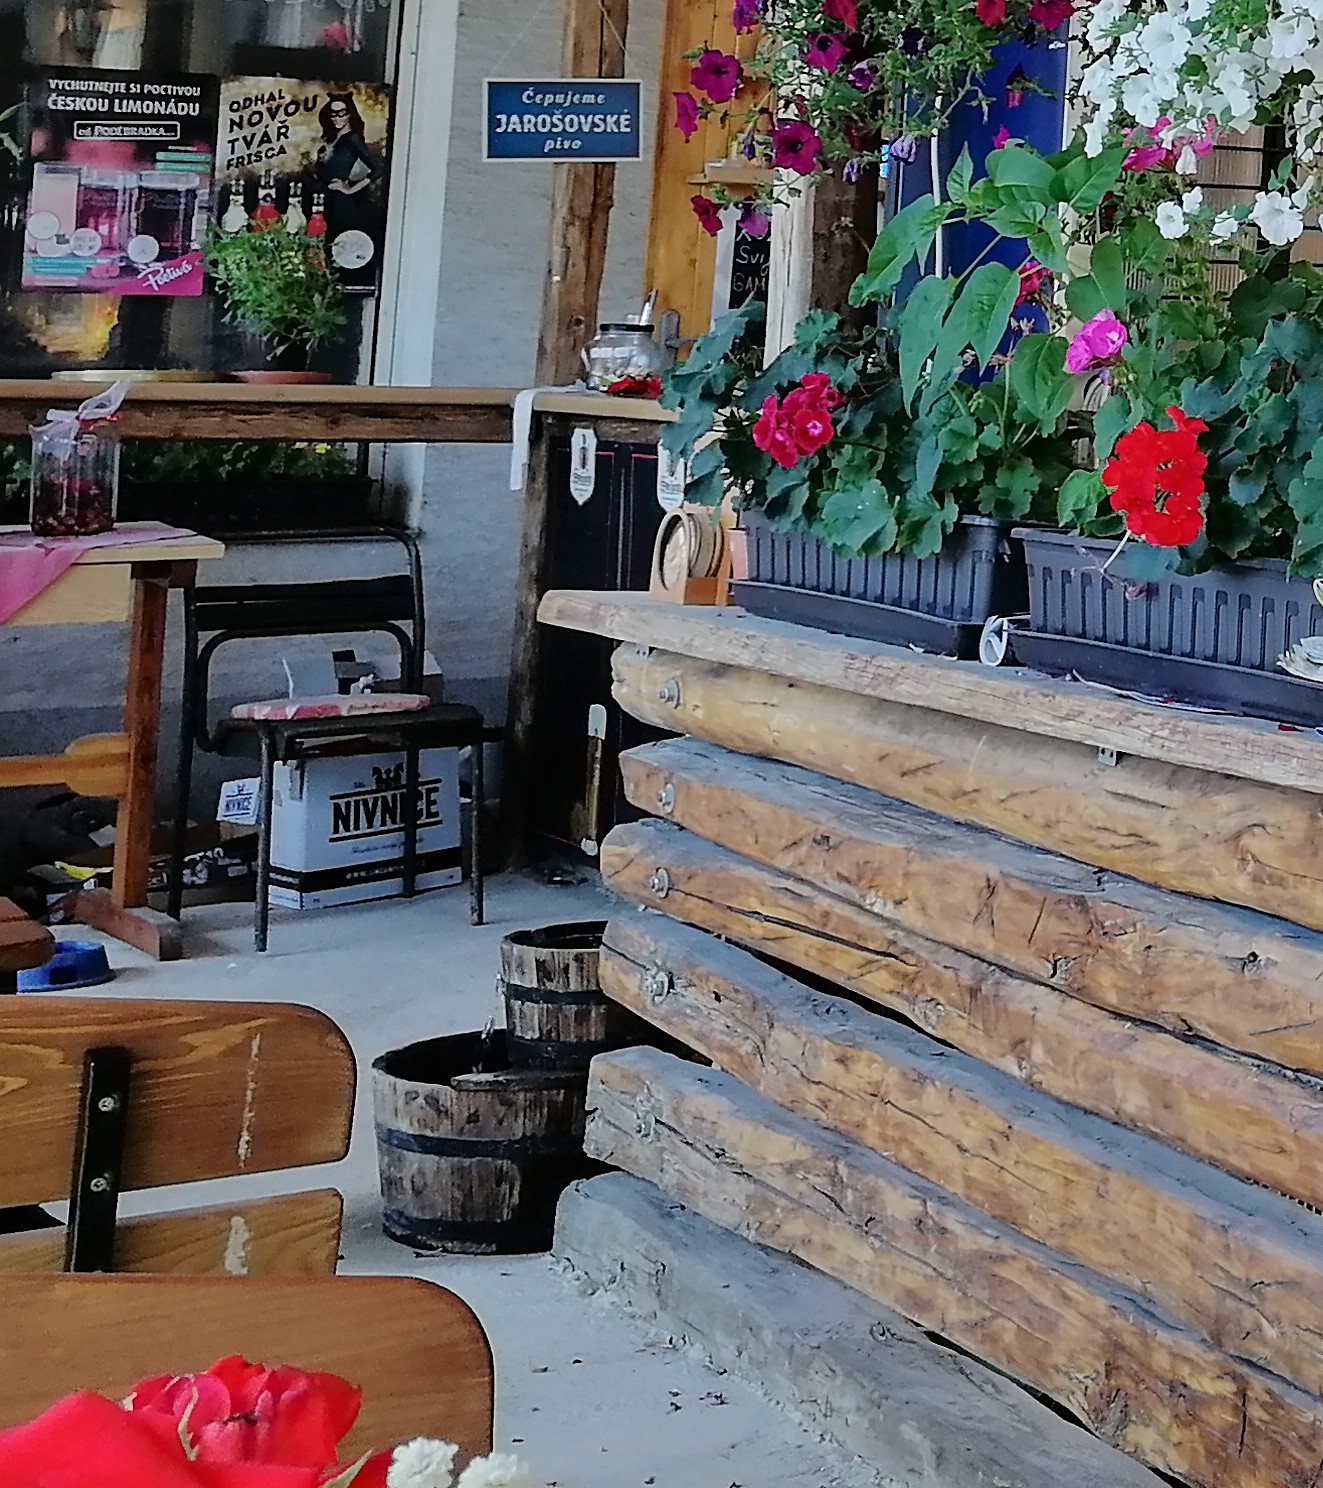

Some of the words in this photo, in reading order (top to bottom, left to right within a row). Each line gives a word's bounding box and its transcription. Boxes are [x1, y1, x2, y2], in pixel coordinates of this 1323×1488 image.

[48, 78, 127, 95] VYCHUTNEJTE
[144, 84, 201, 97] POCTIVOU
[47, 92, 109, 112] ČESKOU
[113, 98, 200, 116] LIMONÁDU
[229, 89, 285, 113] ODHAL
[229, 95, 318, 133] NOVOU
[495, 109, 632, 133] JAROŠOVSKÉ
[228, 119, 289, 155] TVÁŘ
[543, 137, 582, 152] pivo
[226, 145, 287, 171] FRISCA
